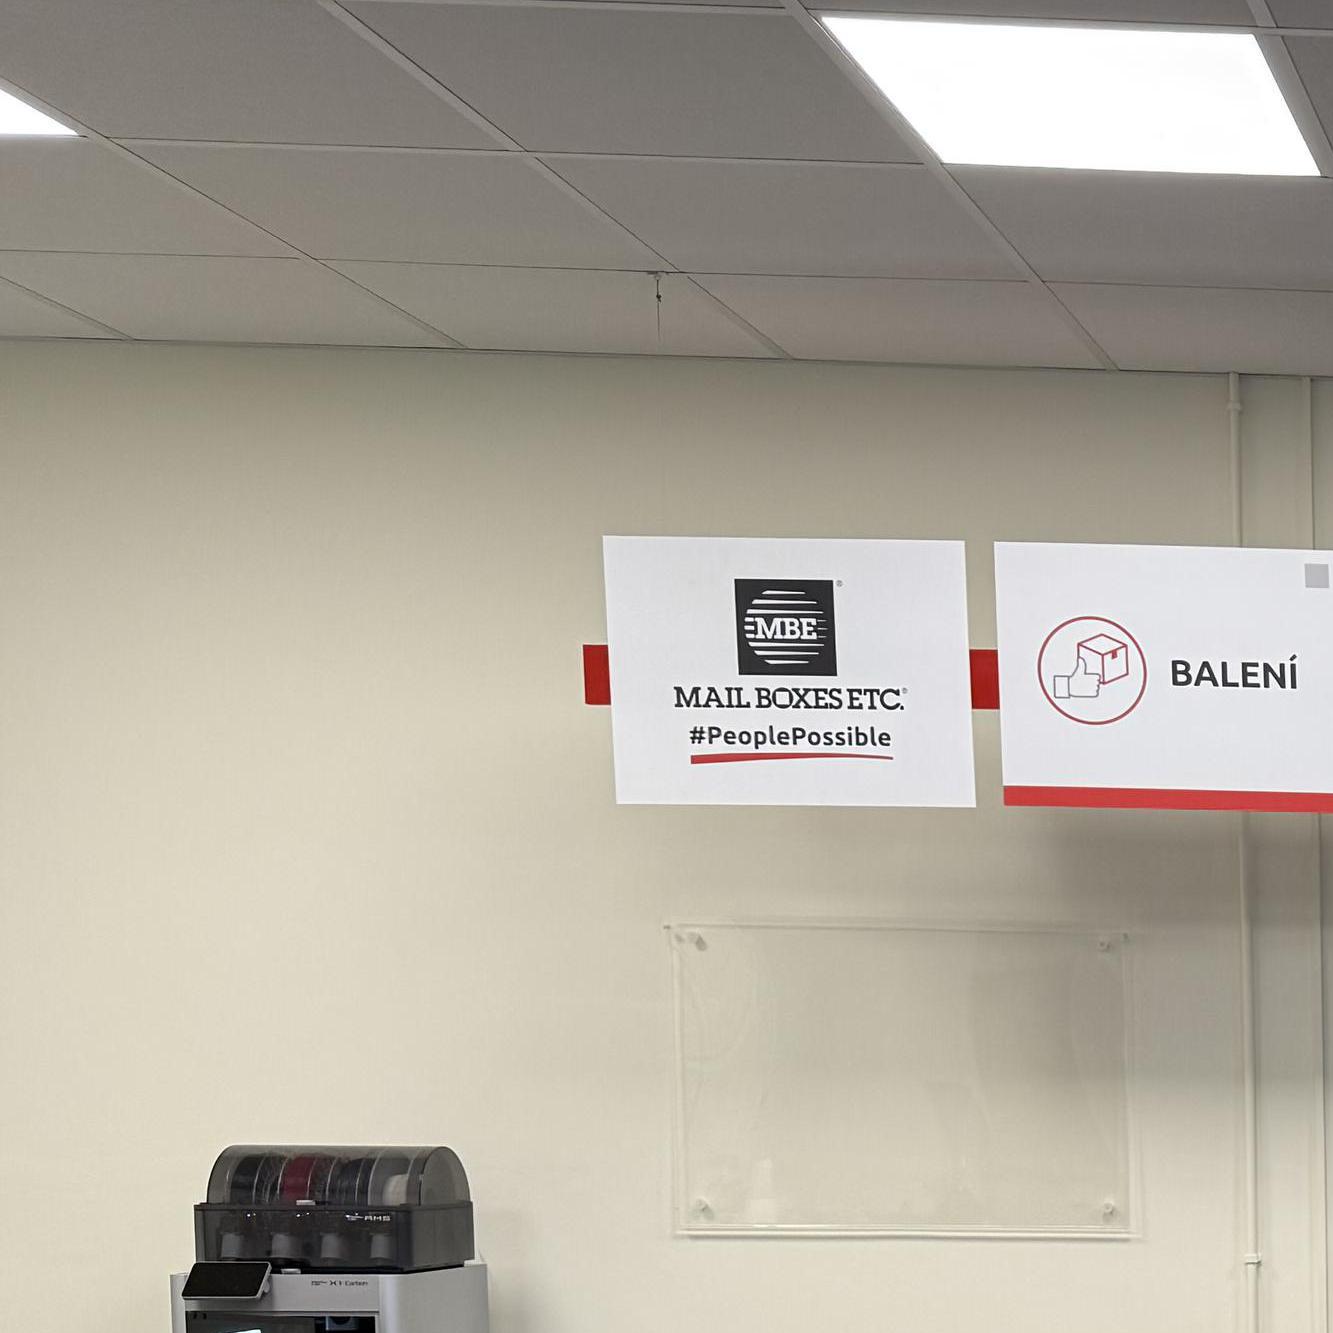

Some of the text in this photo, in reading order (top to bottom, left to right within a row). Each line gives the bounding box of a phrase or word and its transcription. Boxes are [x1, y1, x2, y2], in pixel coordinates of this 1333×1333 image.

[754, 616, 818, 640] MBE
[1171, 654, 1297, 689] BALENÍ
[674, 686, 904, 711] MAIL BOXES ETC.
[689, 725, 891, 750] #PeoplePossible
